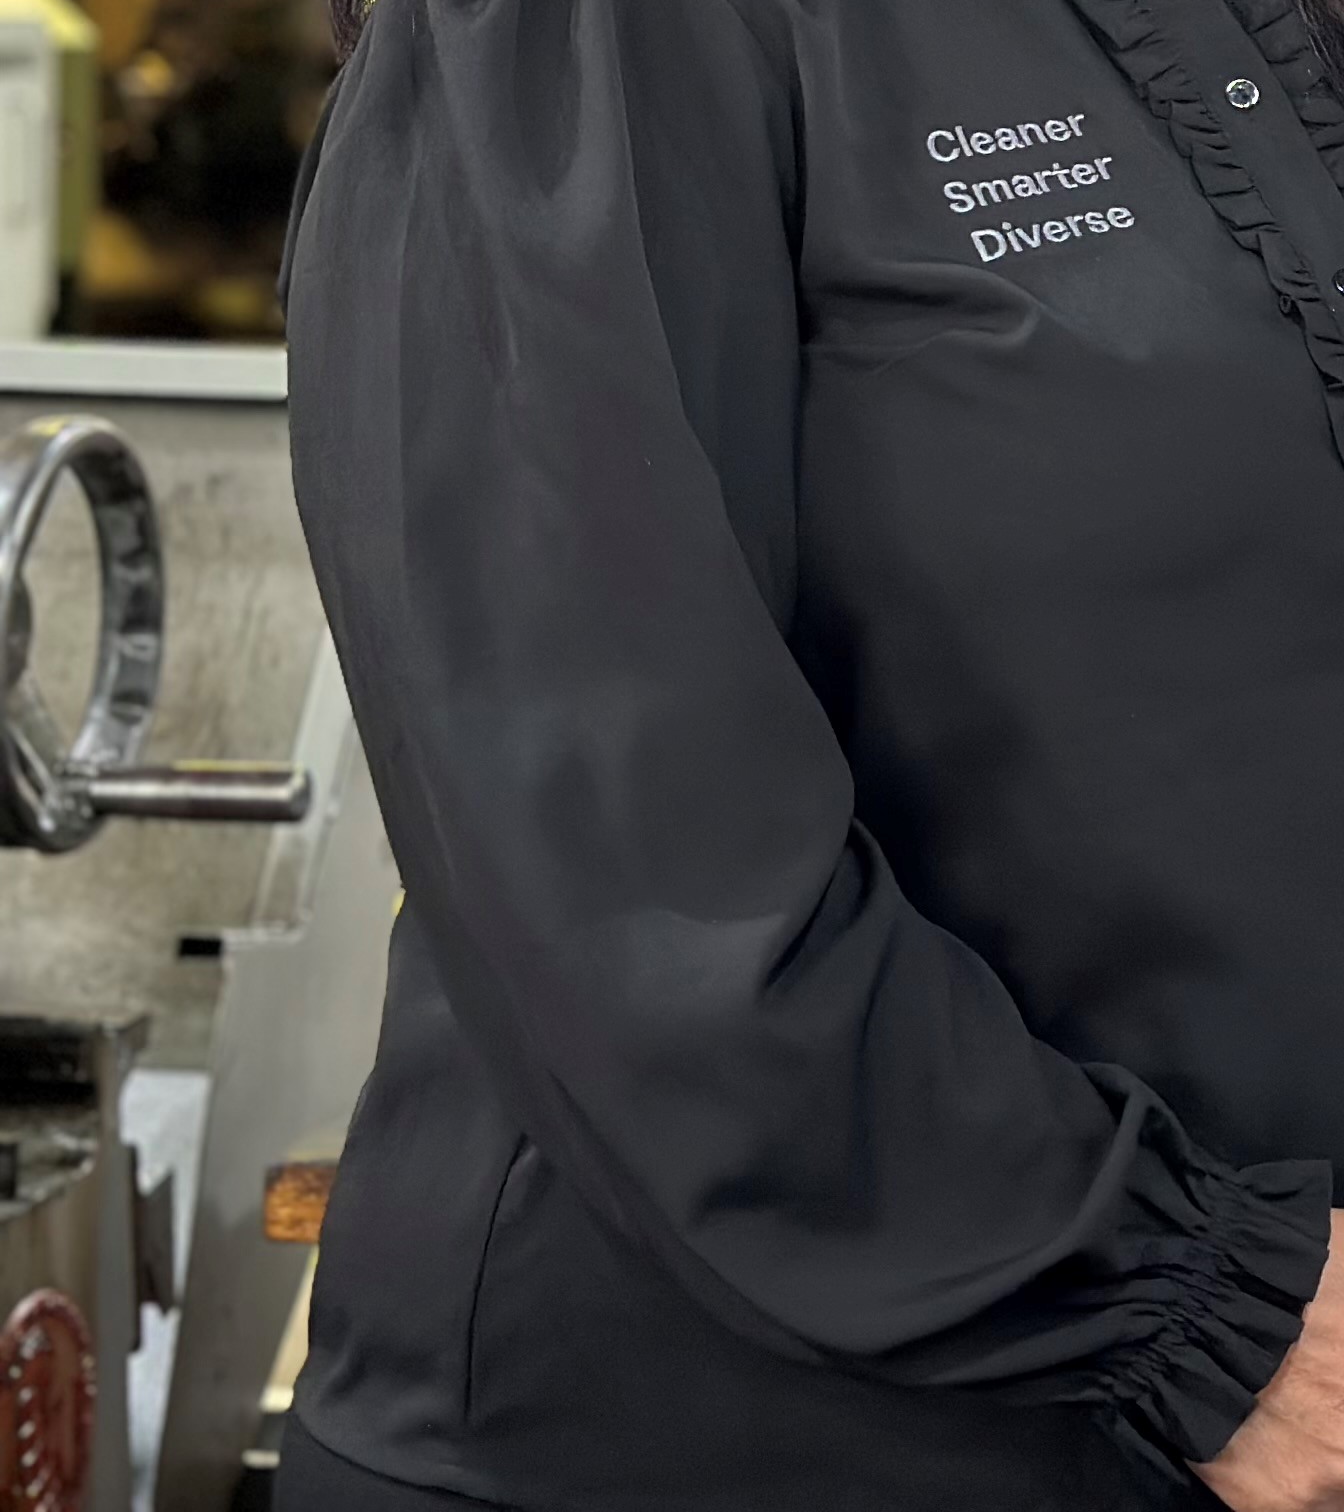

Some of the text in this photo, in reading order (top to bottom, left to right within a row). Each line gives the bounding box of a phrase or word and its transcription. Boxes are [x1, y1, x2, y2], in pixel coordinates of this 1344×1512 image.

[927, 113, 1085, 162] Cleaner
[943, 156, 1112, 213] Smarter
[970, 206, 1135, 263] Diverse
